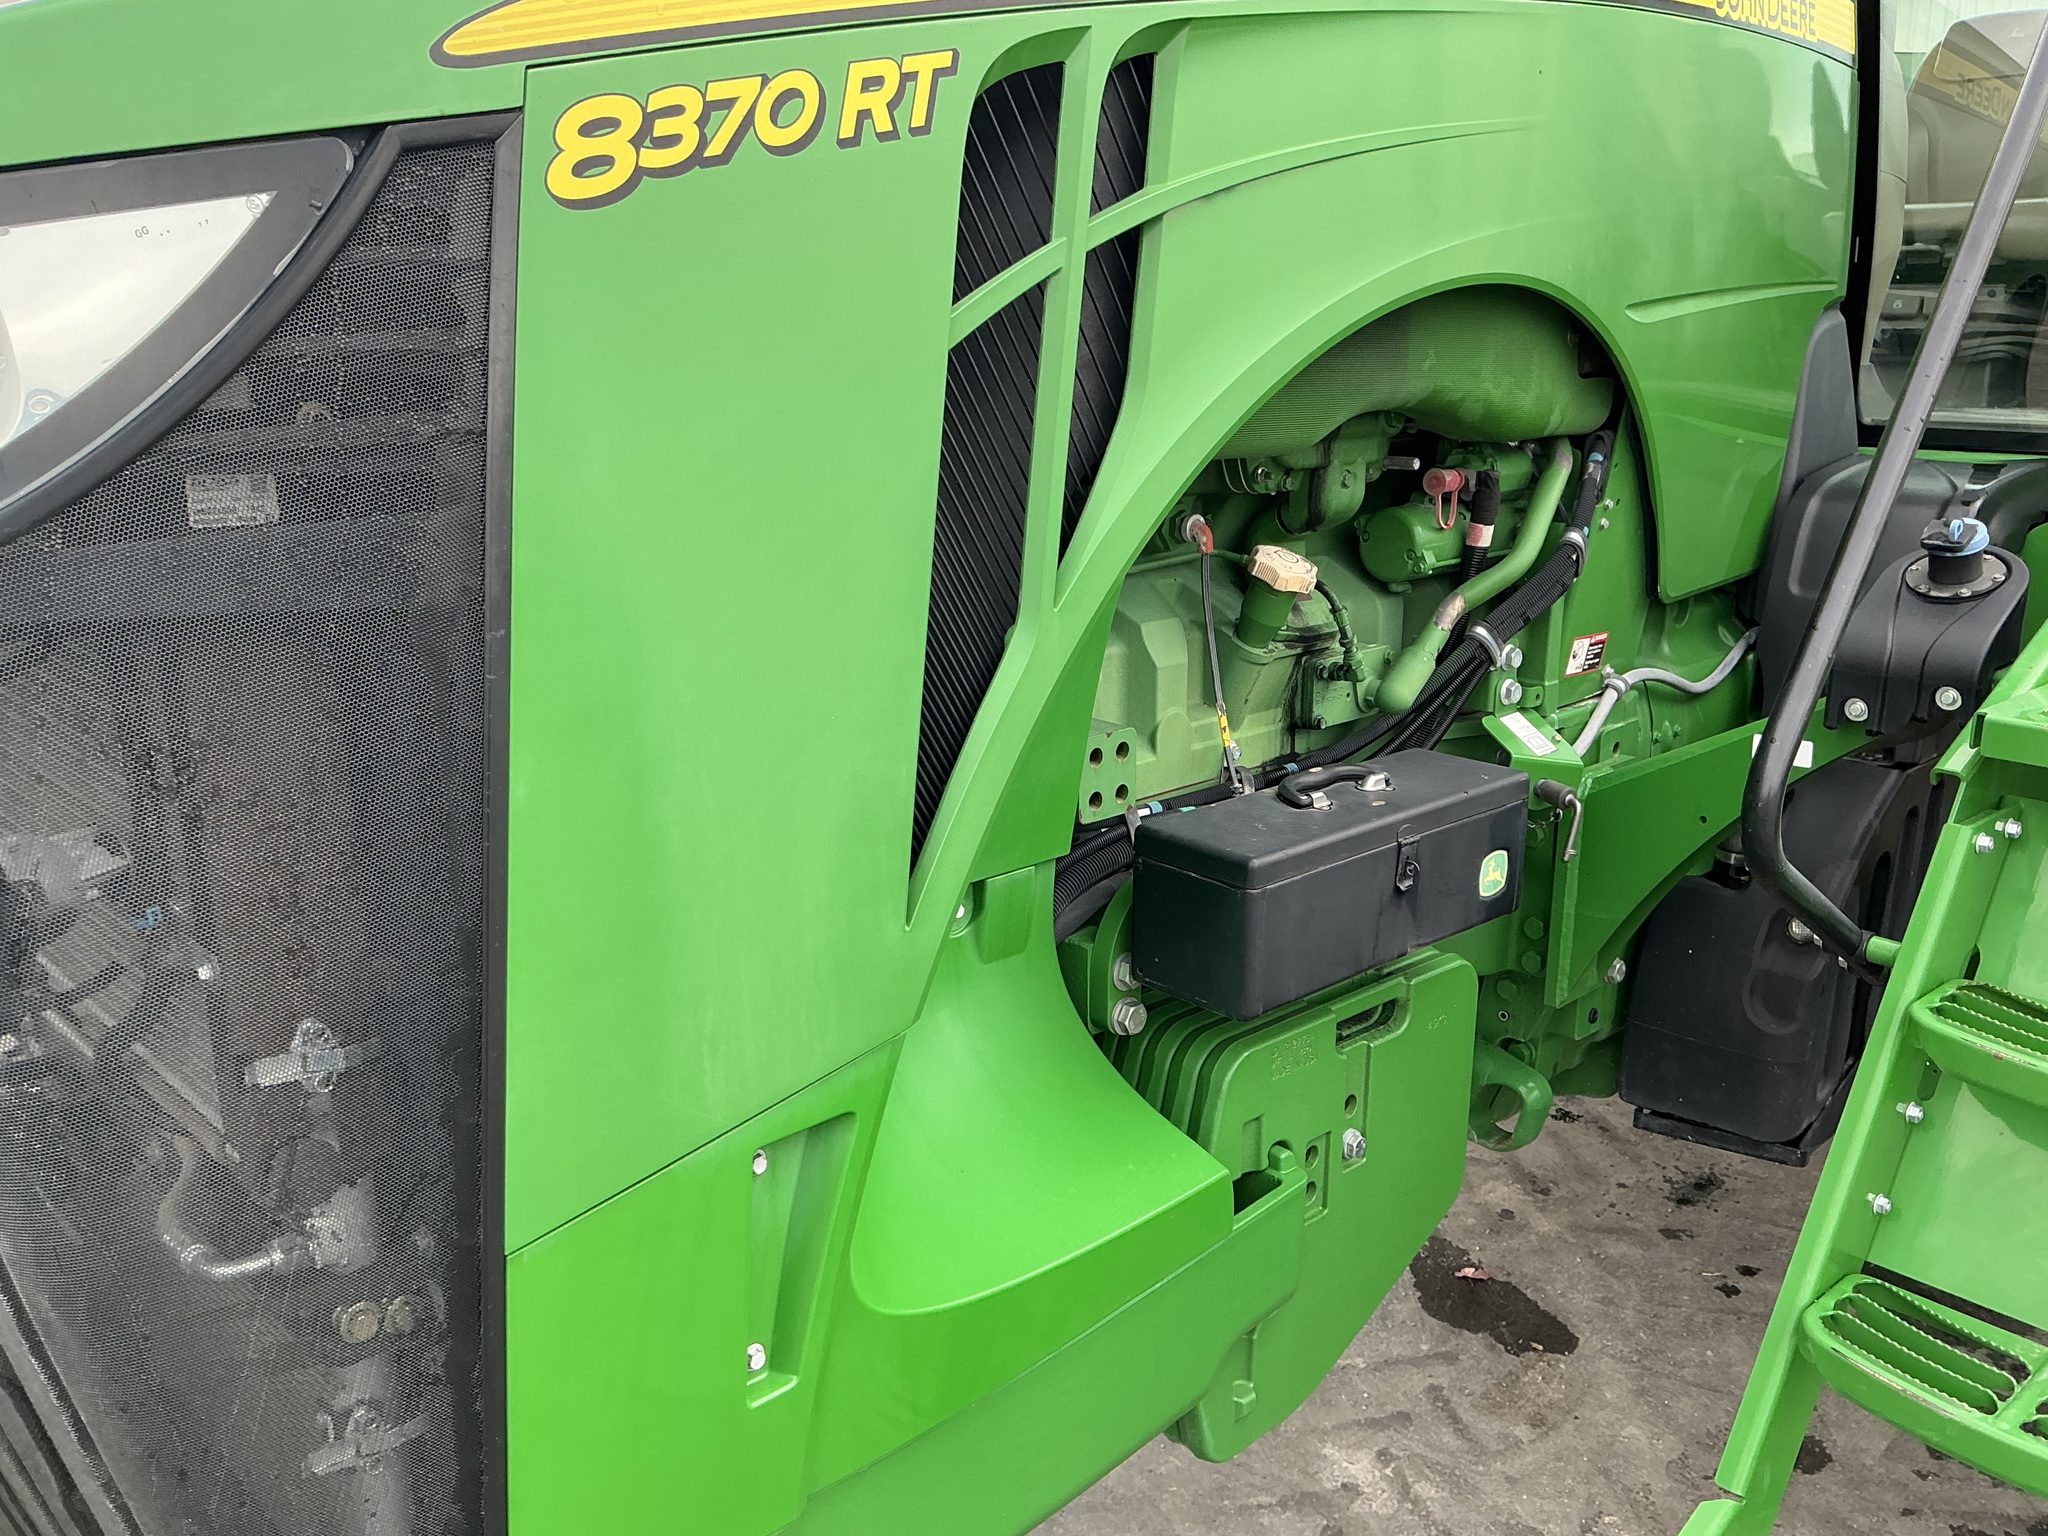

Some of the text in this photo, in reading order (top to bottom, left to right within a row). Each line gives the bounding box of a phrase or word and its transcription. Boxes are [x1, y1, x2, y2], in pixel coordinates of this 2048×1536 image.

[1767, 0, 1818, 41] DEERE
[545, 48, 959, 210] 8370 RT
